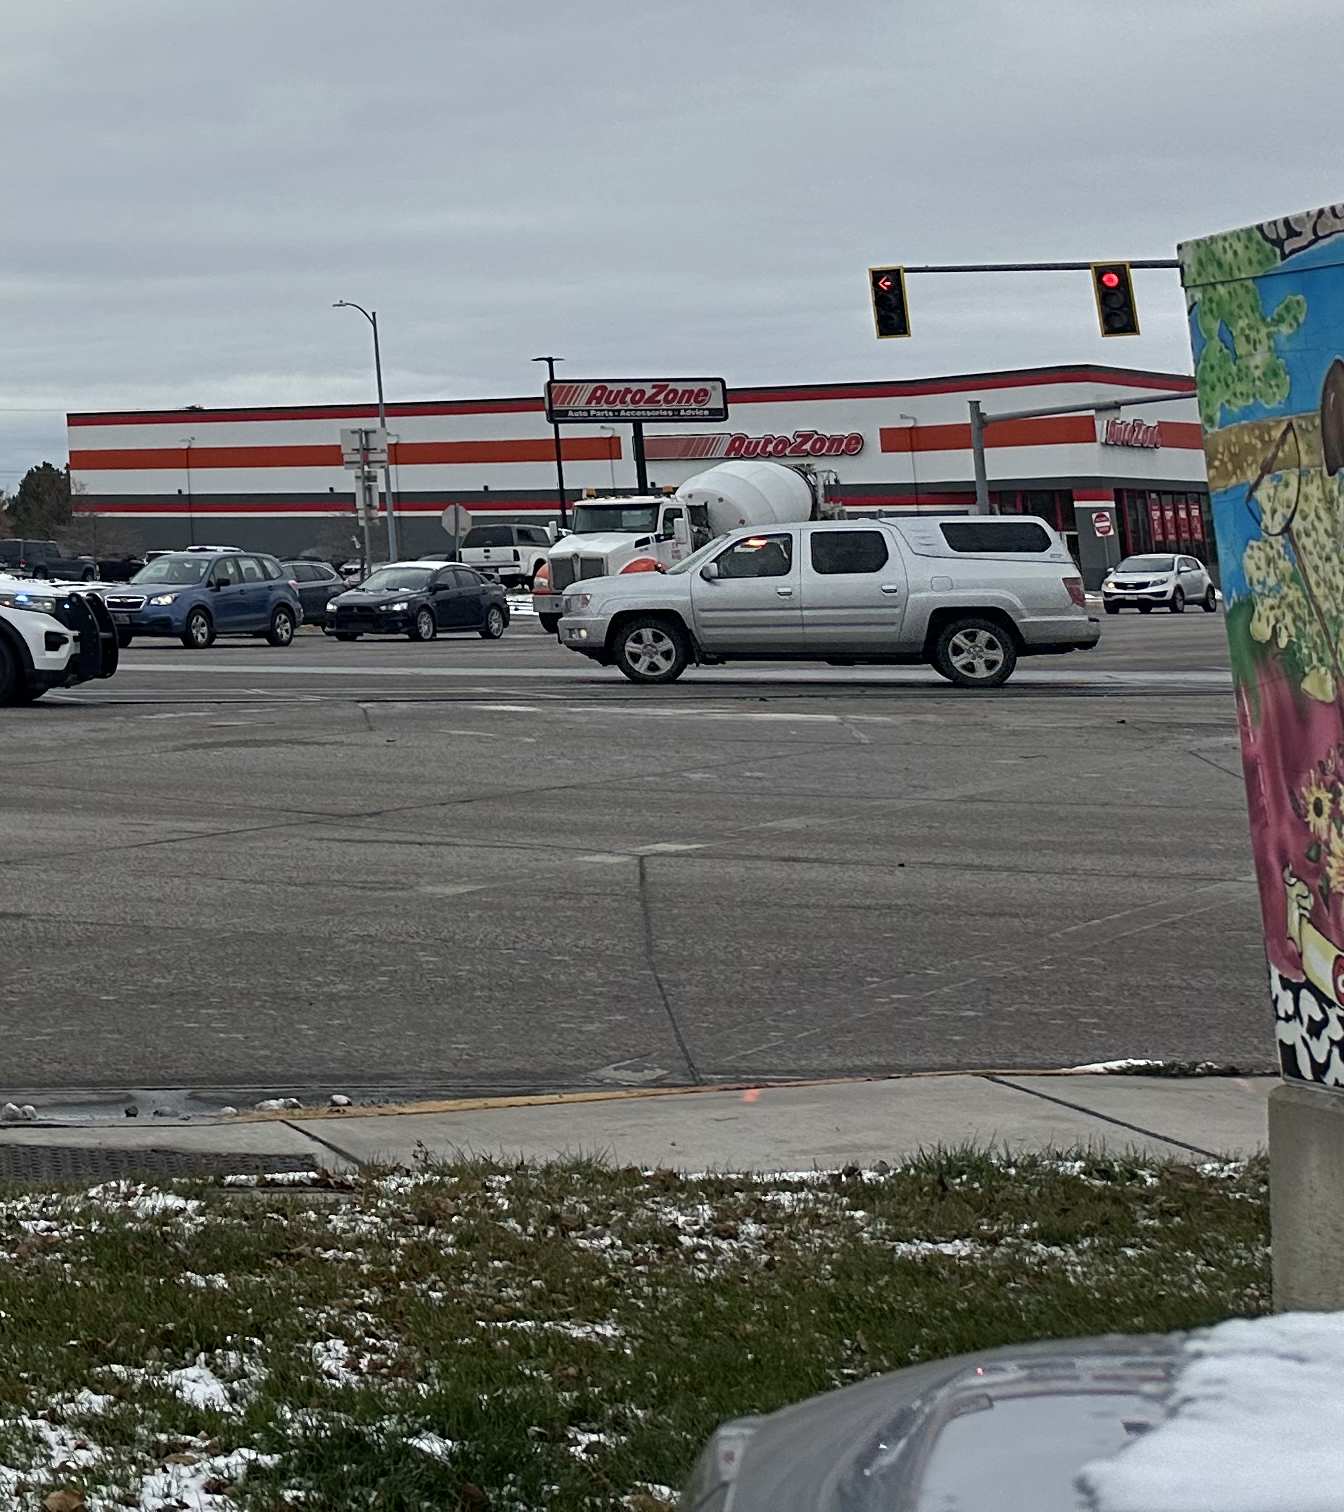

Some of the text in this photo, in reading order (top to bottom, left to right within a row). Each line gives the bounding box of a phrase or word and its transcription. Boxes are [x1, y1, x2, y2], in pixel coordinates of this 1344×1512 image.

[585, 383, 711, 405] AutoZone
[567, 408, 710, 418] Auto Parts Accessories Advice
[724, 431, 864, 458] AutoZone
